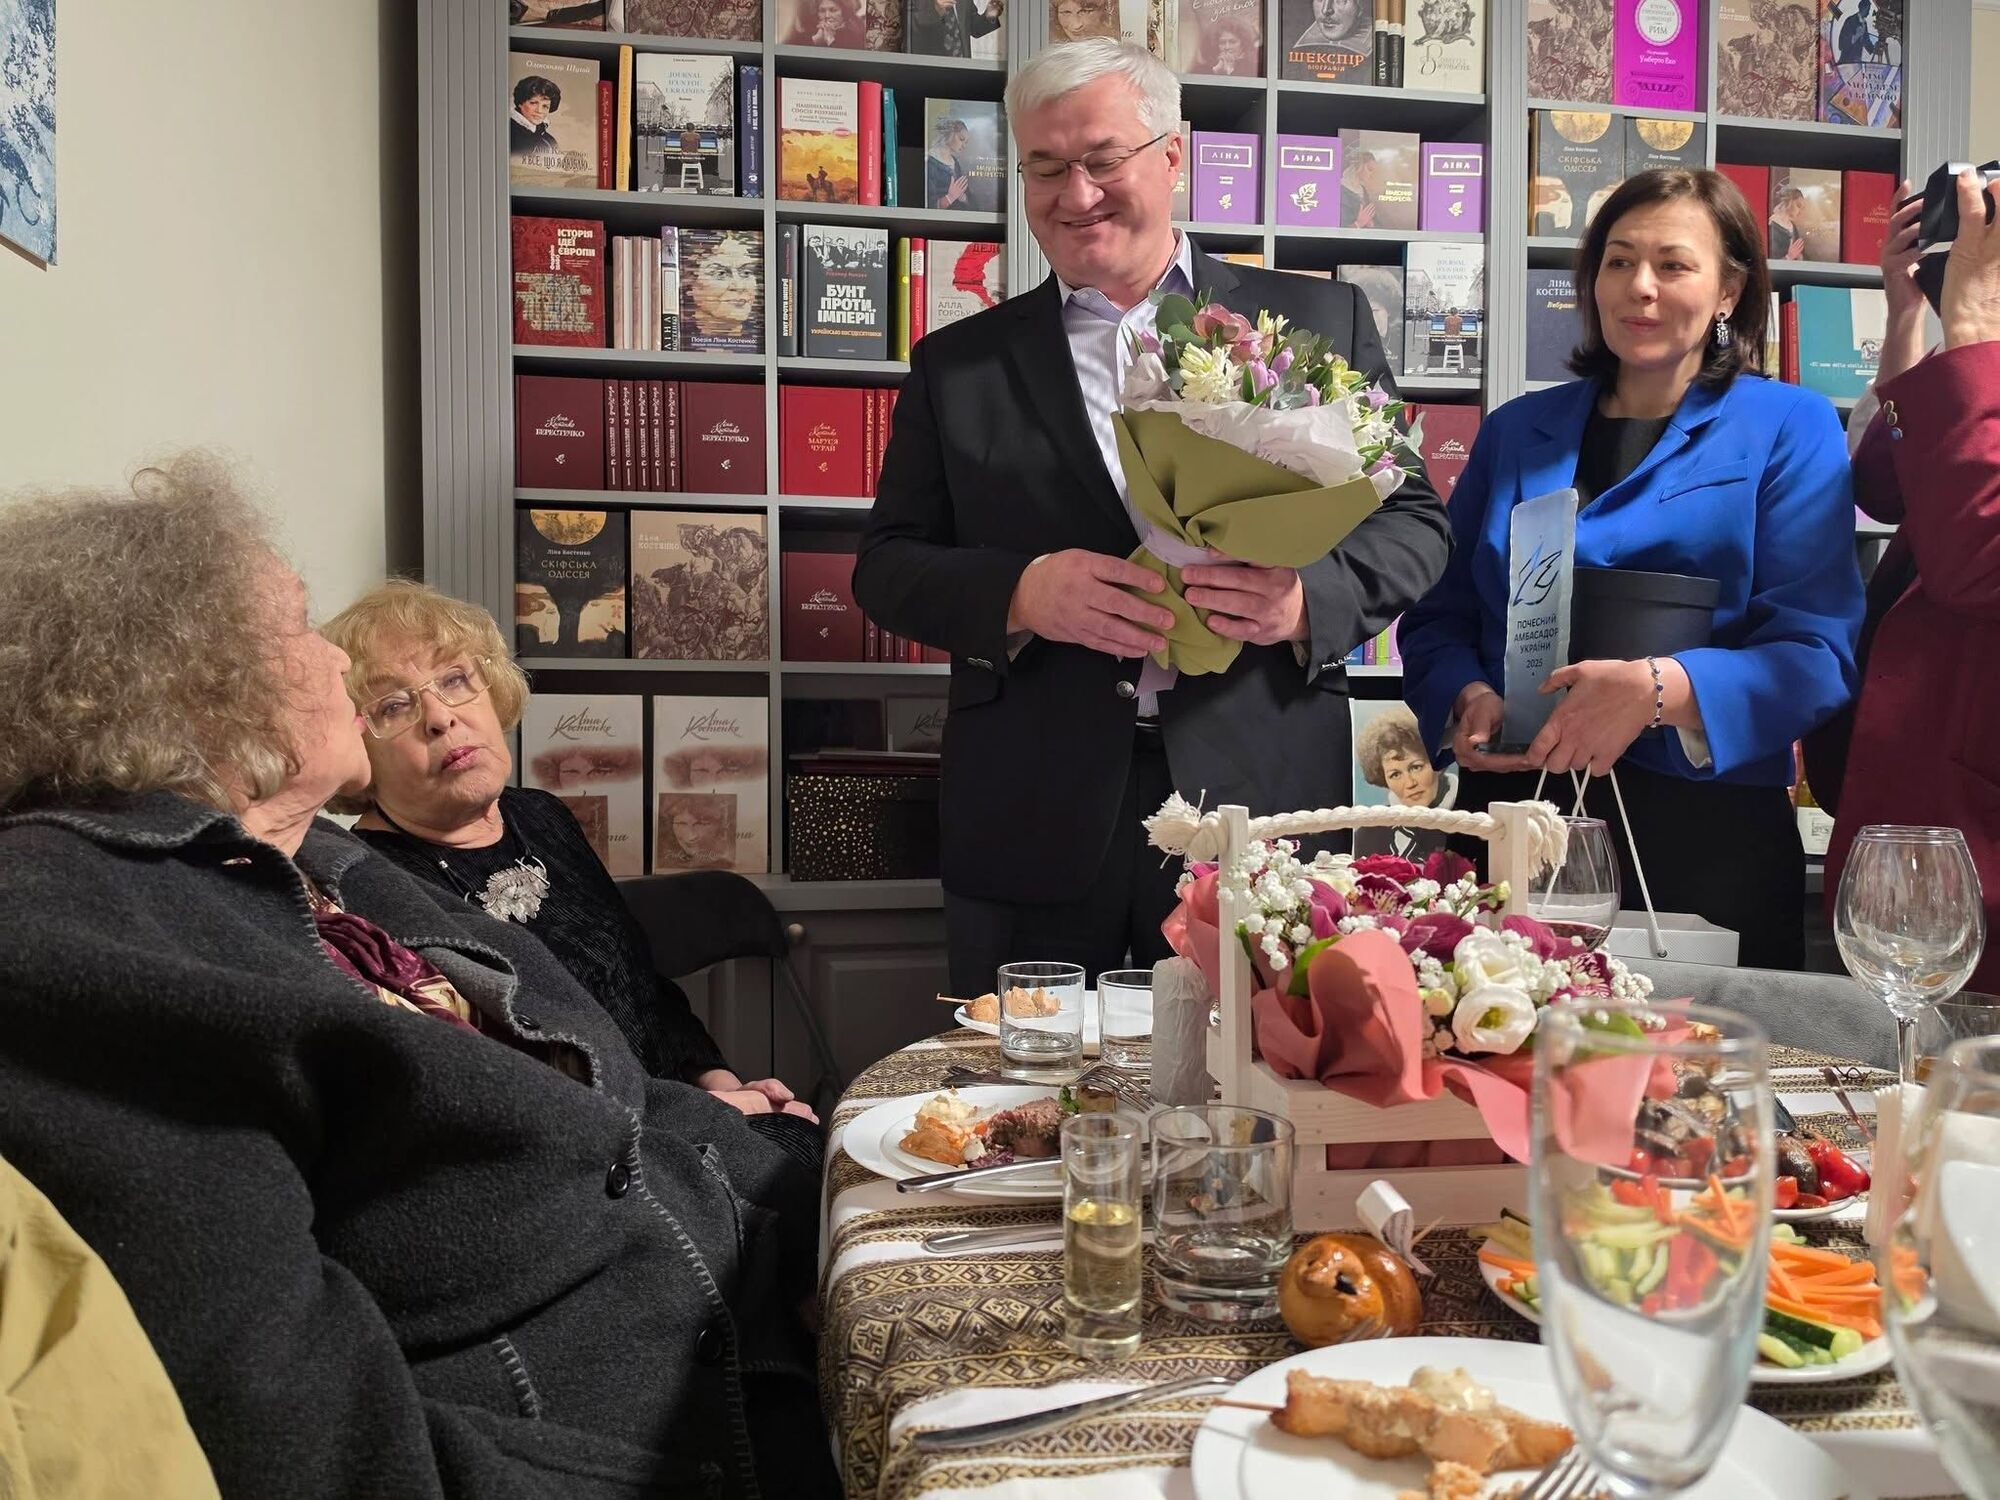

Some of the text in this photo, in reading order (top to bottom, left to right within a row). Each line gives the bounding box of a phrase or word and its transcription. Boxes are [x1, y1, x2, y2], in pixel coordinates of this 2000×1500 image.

[1288, 51, 1364, 68] ШЕКСПІР
[1212, 152, 1240, 160] ЛІНА
[1293, 153, 1321, 162] ЛІНА
[1558, 155, 1602, 164] СКІФСЬКА
[1442, 161, 1471, 169] ЛІНА
[1564, 165, 1597, 173] ОДІССЕЯ
[557, 229, 593, 238] ІСТОРІЯ
[558, 248, 596, 257] ЄВРОПИ
[826, 284, 866, 298] БУНТ
[821, 296, 872, 311] ПРОТИ
[938, 301, 962, 309] АЛЛА
[817, 309, 876, 325] ІМПЕРІЇ
[663, 316, 671, 351] ЛІНА
[541, 560, 597, 569] СКІФСЬКА
[548, 570, 590, 579] ОДІССЕЯ
[1517, 615, 1557, 630] ПОЧЕСНИЙ
[1513, 628, 1559, 642] АМБАСАДОР
[1519, 642, 1551, 655] УКРАЇНИ
[1526, 658, 1543, 669] 2025
